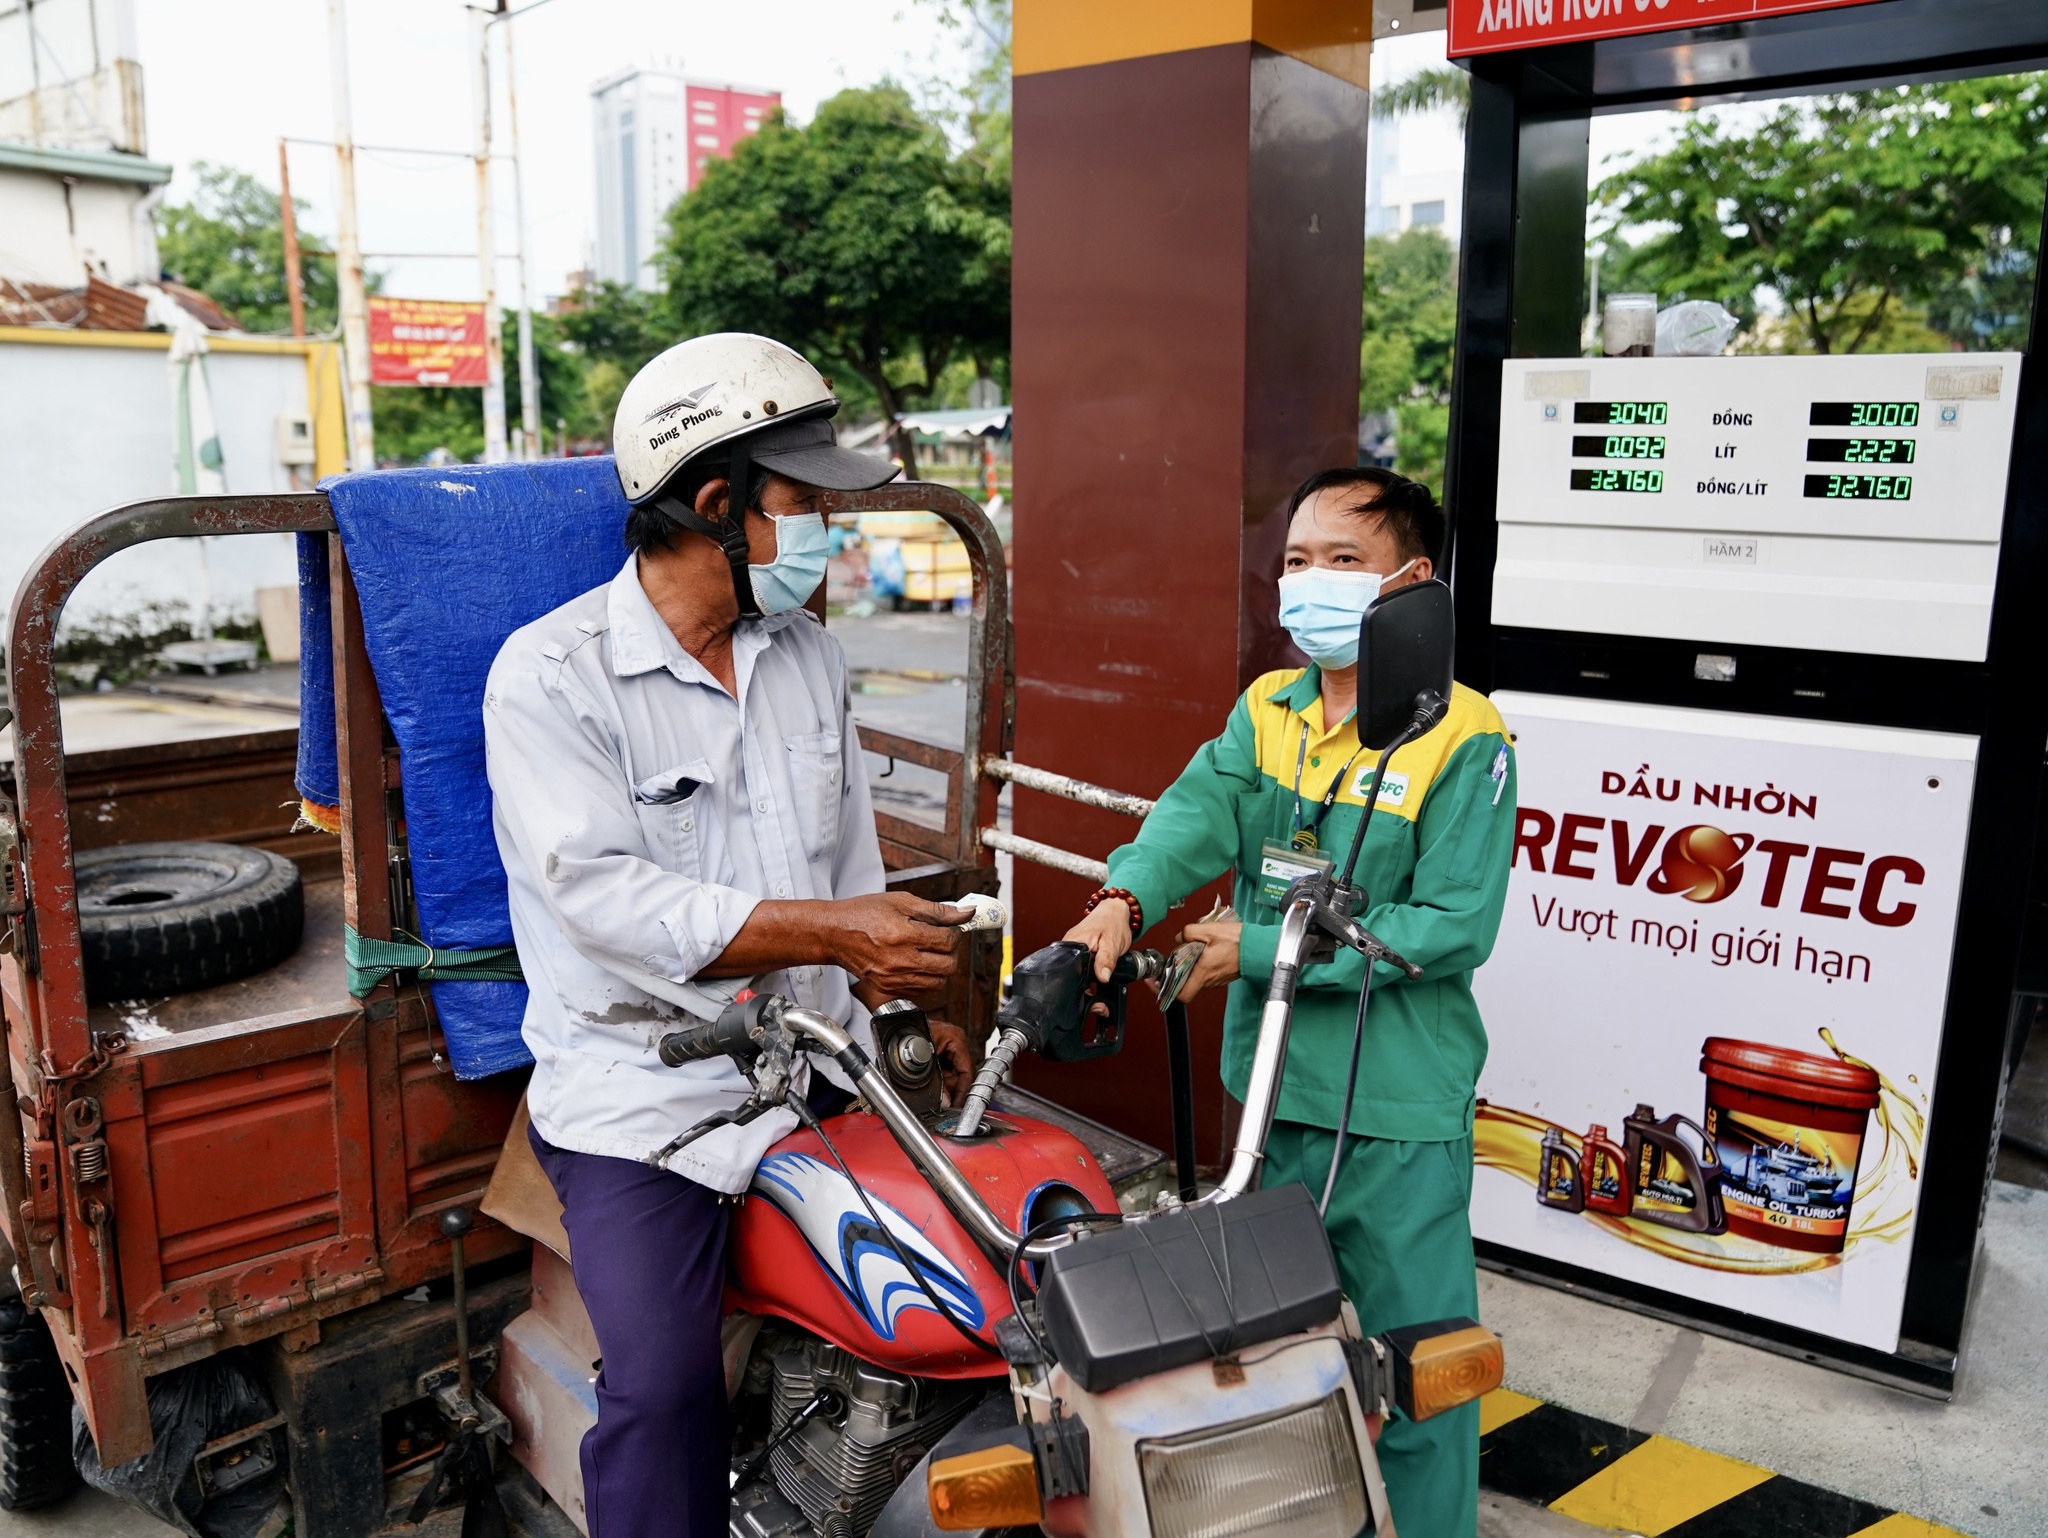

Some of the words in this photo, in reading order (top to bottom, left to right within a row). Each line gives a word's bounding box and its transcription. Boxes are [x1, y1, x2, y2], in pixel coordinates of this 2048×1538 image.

[649, 426, 680, 450] Dũng
[681, 403, 723, 430] Phong
[1715, 442, 1737, 458] LÍT
[1591, 470, 1662, 491] 32.760
[1827, 476, 1911, 499] 32.760
[1746, 546, 1753, 557] 2
[1379, 780, 1404, 797] SFC
[1601, 763, 1681, 802] DẦU
[1693, 782, 1818, 820] NHỜN
[1511, 806, 1926, 928] REVOTEC
[1532, 893, 1618, 942] Vượt
[1631, 919, 1698, 957] mọi
[1711, 927, 1781, 967] giới
[1795, 936, 1871, 984] hạn
[1721, 1184, 1766, 1208] ENGINE
[1768, 1200, 1793, 1214] OIL
[1768, 1213, 1788, 1226] 40
